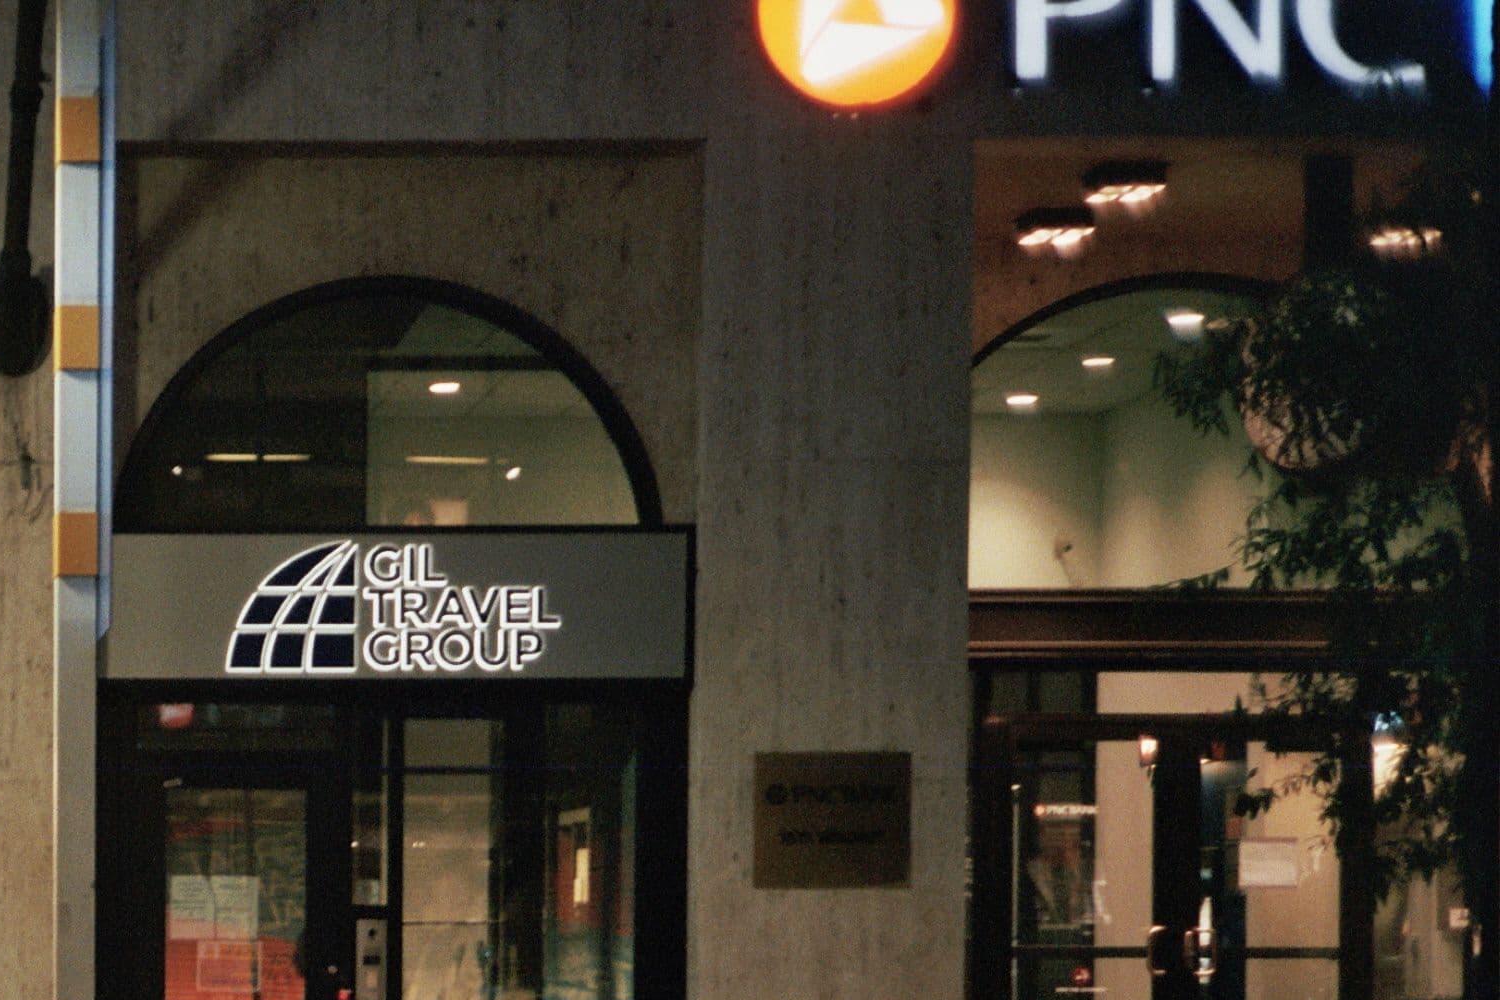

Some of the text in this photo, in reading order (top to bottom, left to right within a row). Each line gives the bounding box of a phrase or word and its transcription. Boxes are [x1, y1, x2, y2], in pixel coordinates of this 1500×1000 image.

[363, 542, 449, 588] GIL
[362, 585, 563, 630] TRAVEL
[362, 627, 546, 672] GROUP
